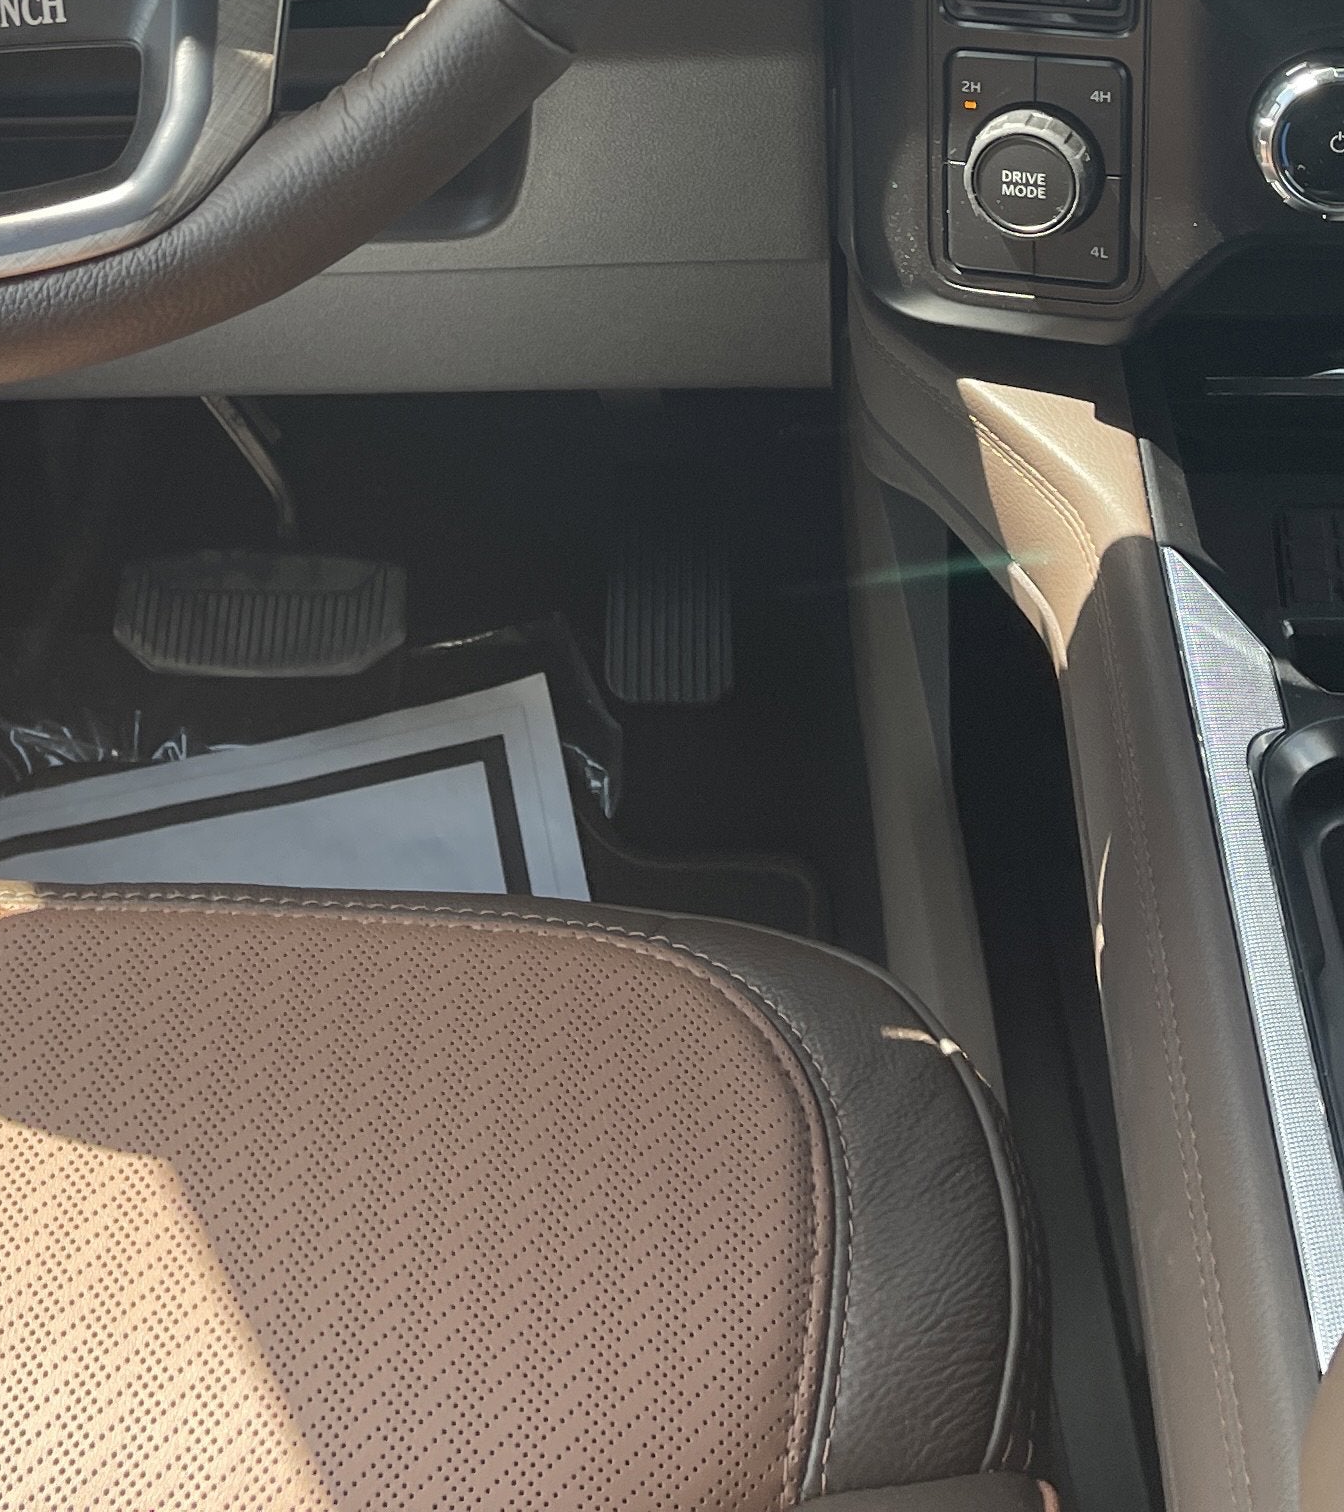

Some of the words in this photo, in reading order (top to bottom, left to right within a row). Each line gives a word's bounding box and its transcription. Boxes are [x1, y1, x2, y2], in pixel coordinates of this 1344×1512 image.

[961, 81, 981, 94] 2H
[1090, 90, 1111, 104] 4H
[1001, 170, 1046, 185] DRIVE
[1001, 183, 1046, 199] MODE
[1090, 246, 1108, 259] 4L
